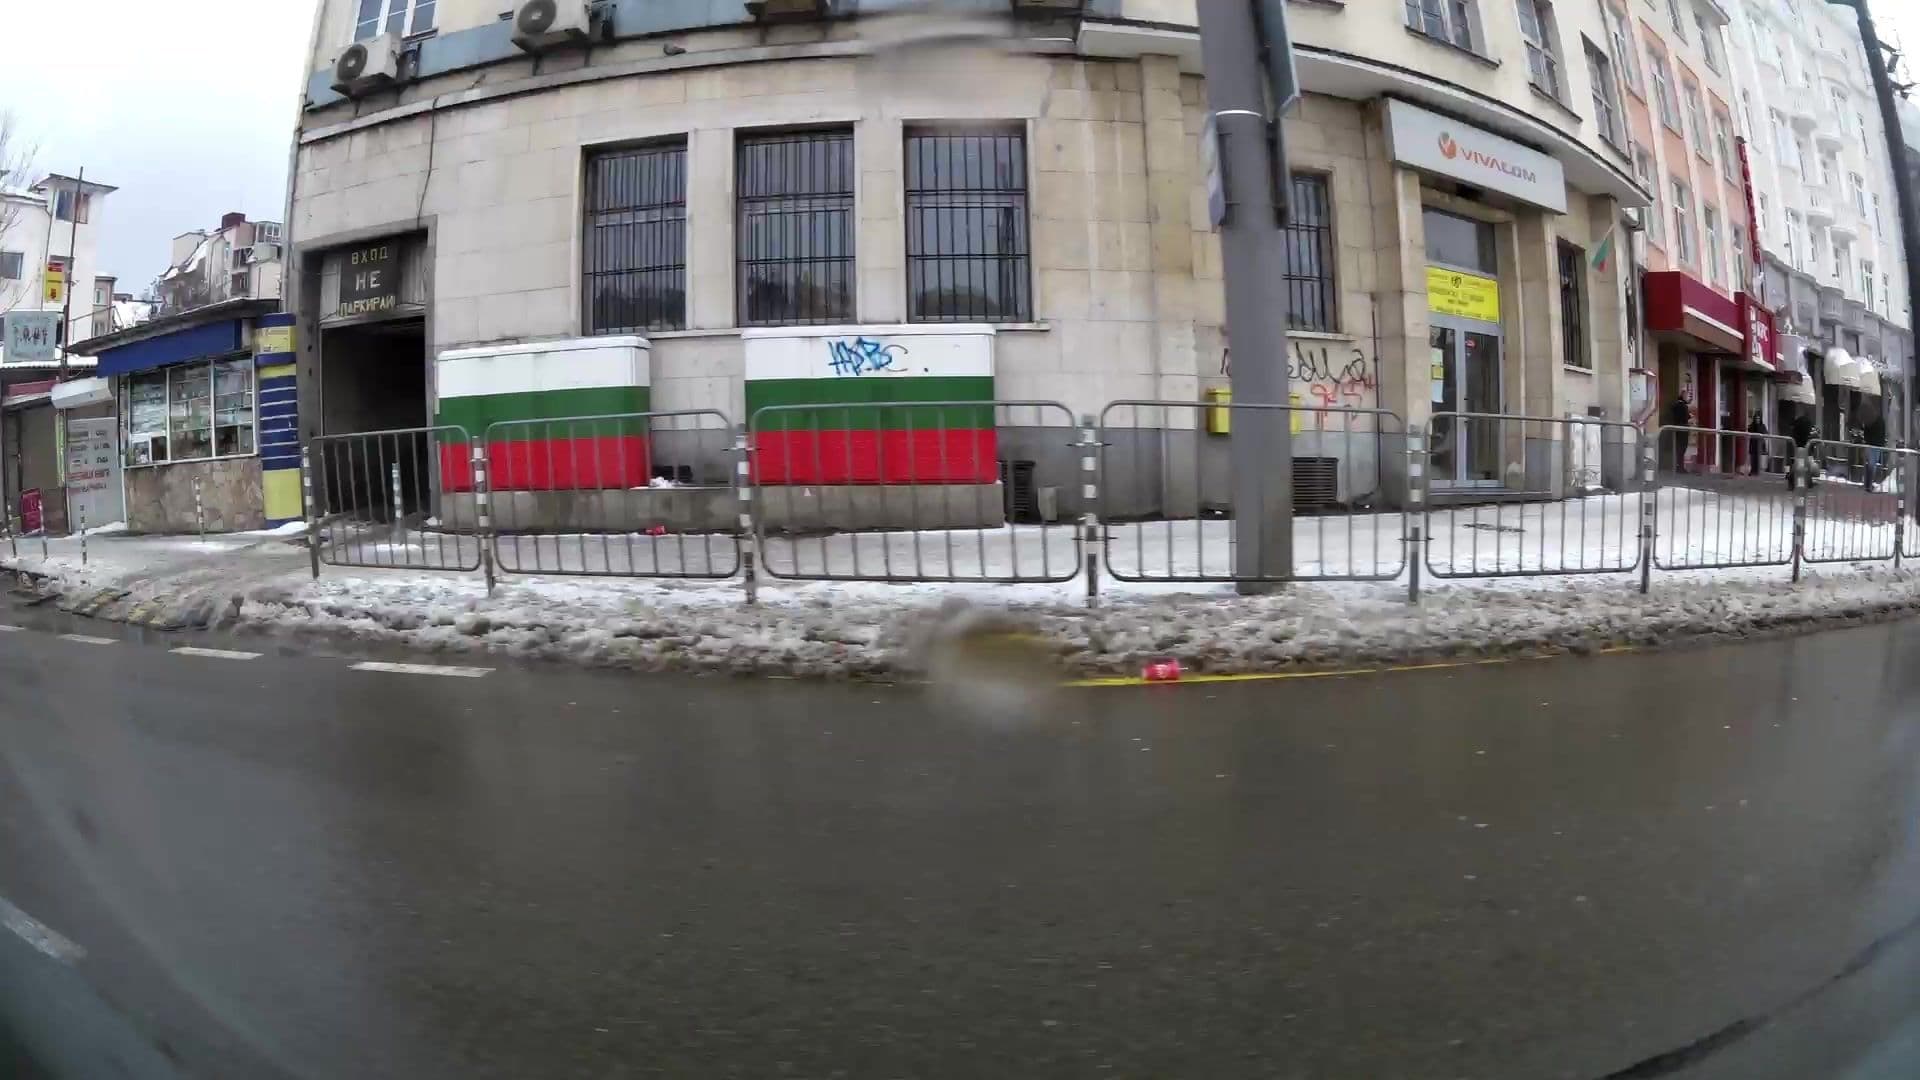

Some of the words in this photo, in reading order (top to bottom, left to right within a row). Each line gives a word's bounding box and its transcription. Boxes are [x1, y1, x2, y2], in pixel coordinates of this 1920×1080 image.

[1460, 147, 1537, 184] VIVACOM
[351, 246, 388, 265] ВХОД
[355, 270, 381, 291] НЕ
